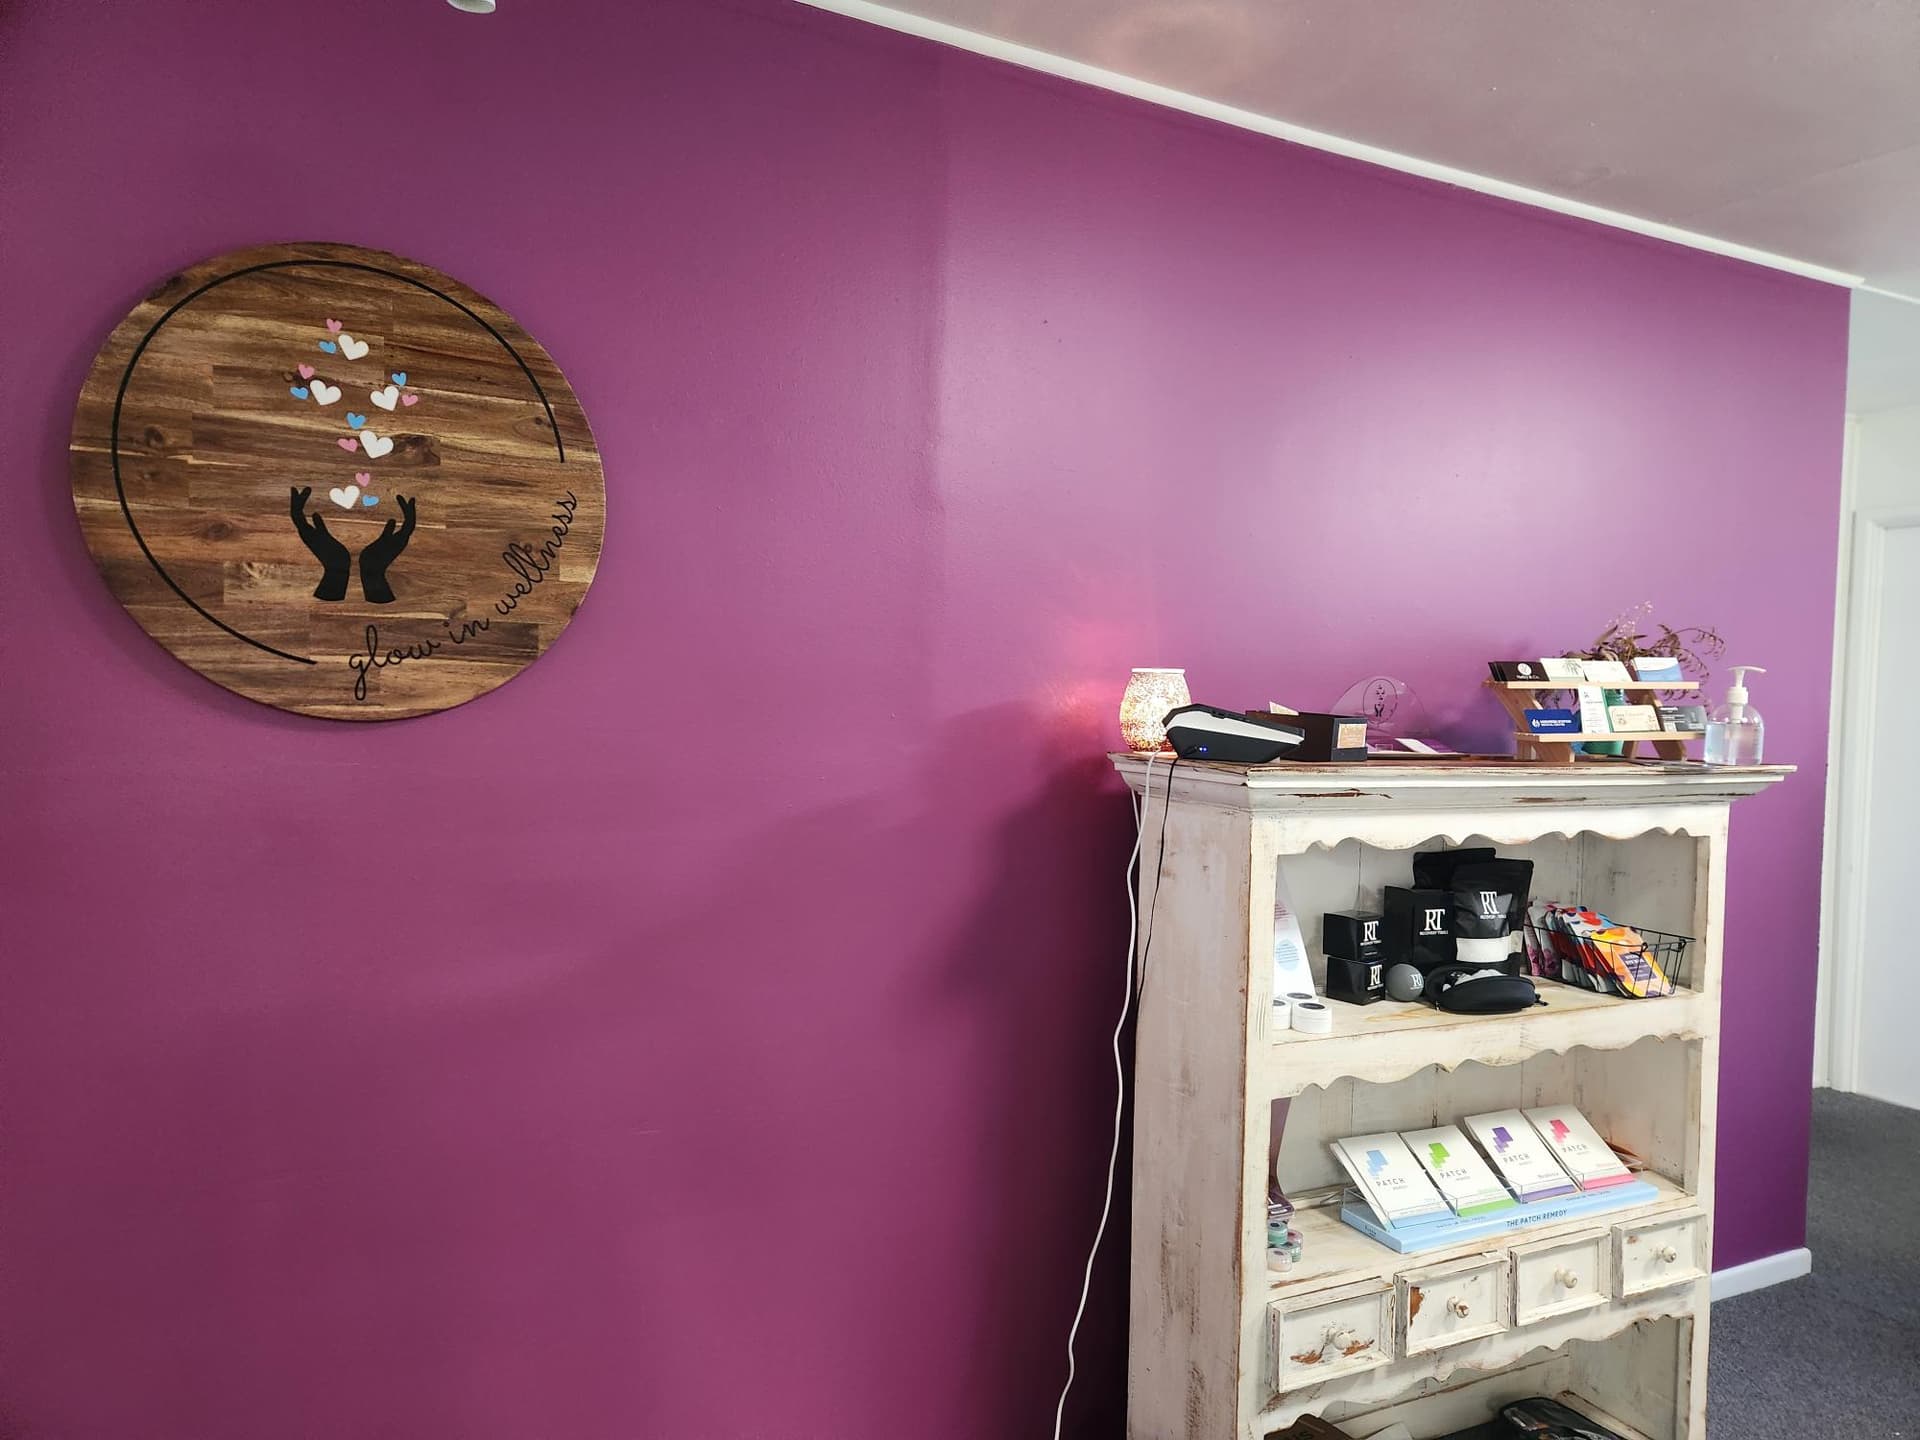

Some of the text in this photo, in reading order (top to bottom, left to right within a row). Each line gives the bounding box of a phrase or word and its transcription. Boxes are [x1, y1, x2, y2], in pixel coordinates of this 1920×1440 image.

[349, 490, 578, 701] glow in wellness
[1480, 891, 1499, 914] RT
[1424, 909, 1445, 930] RT
[1363, 920, 1379, 941] RT
[1370, 964, 1383, 986] RT
[1502, 1153, 1530, 1163] PATCH
[1561, 1143, 1588, 1153] PATCH
[1375, 1177, 1406, 1187] PATCH
[1439, 1168, 1468, 1178] PATCH
[1506, 1208, 1568, 1228] THE PATCH REMEDY
